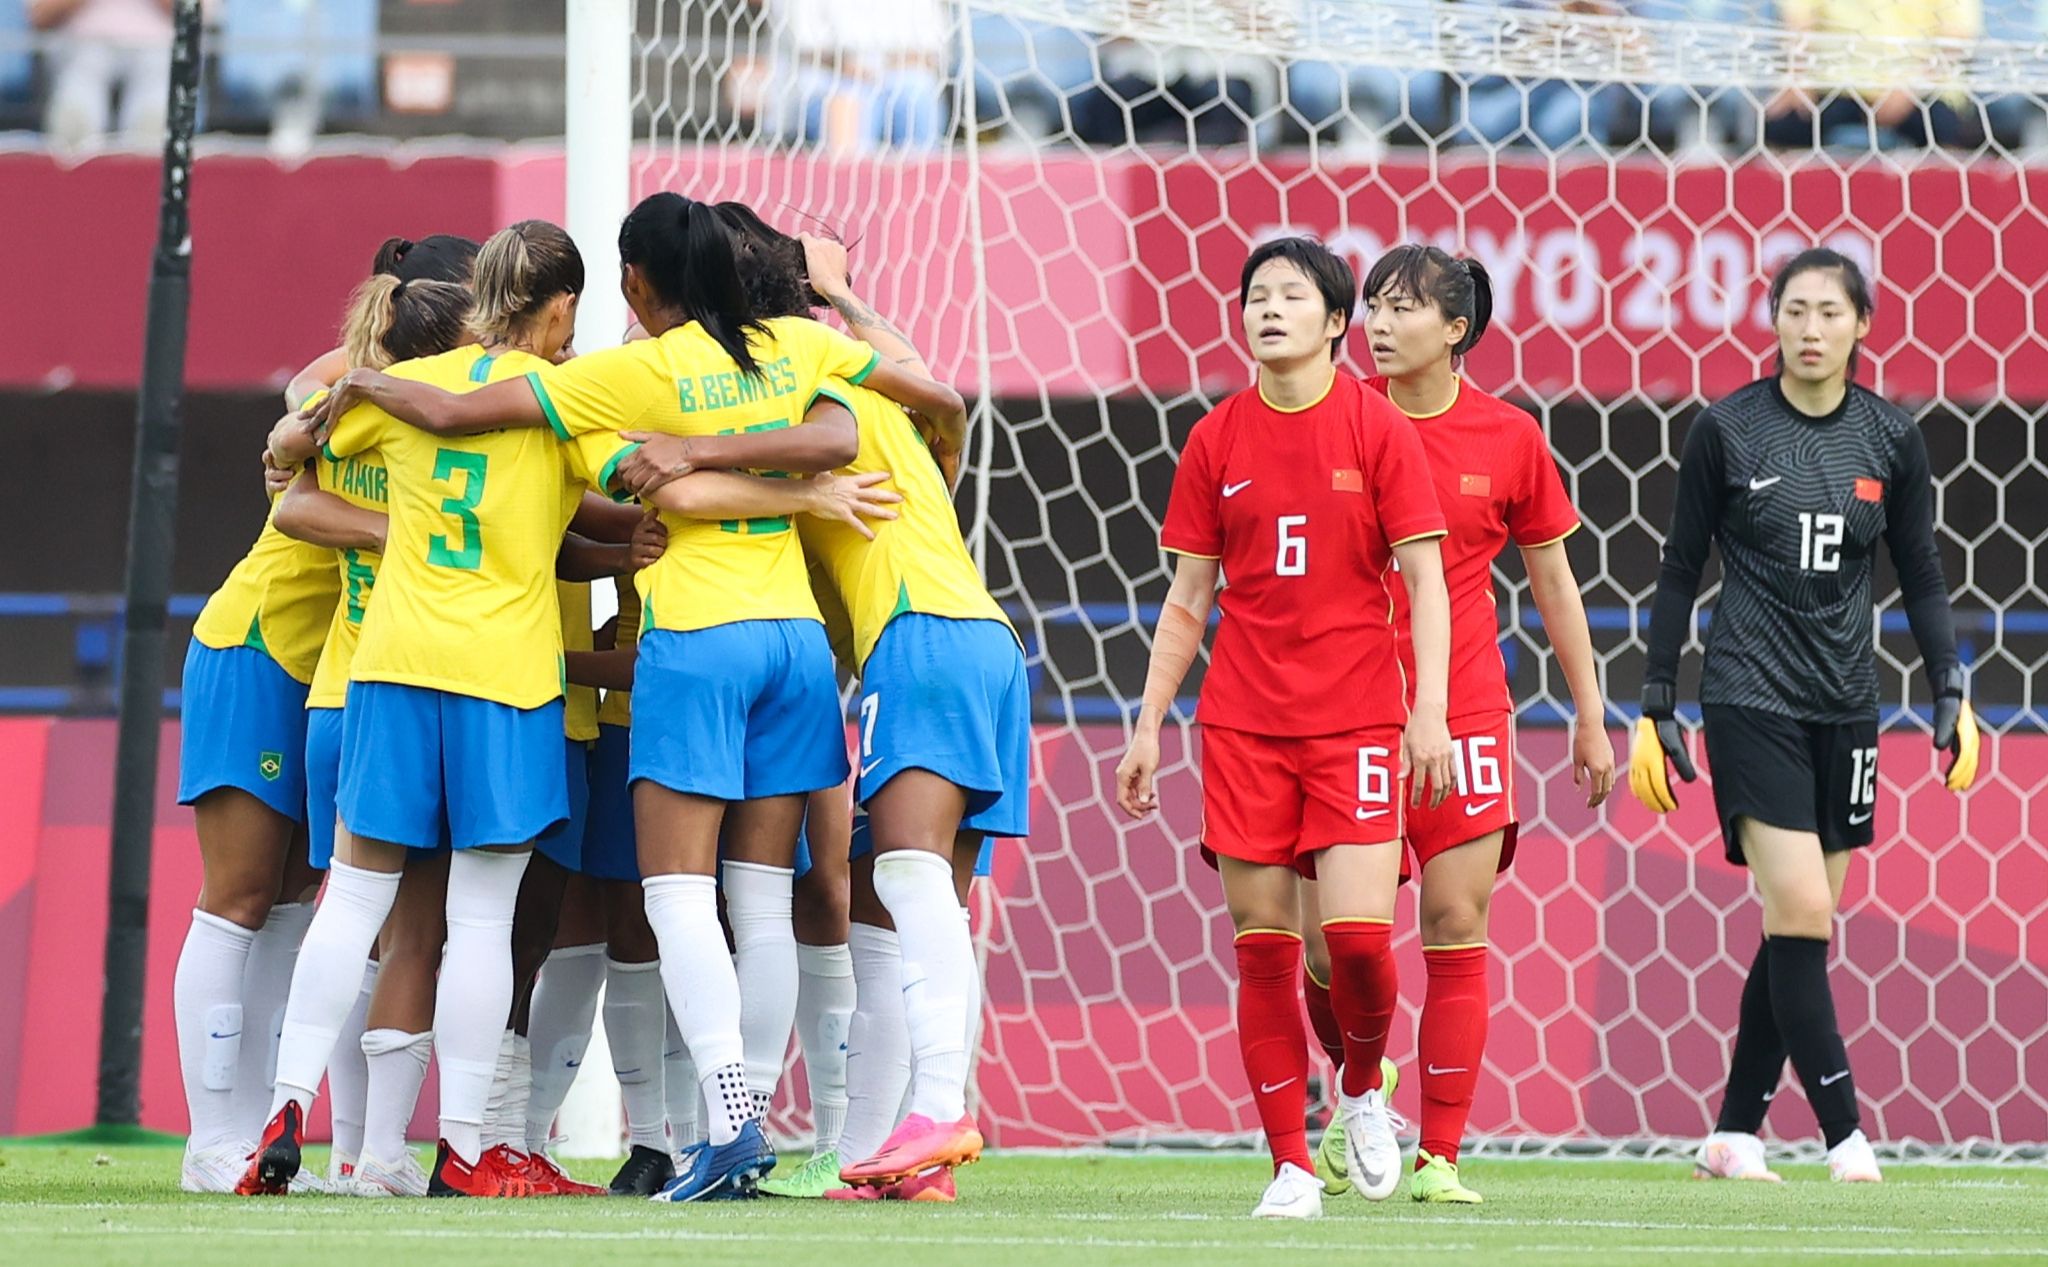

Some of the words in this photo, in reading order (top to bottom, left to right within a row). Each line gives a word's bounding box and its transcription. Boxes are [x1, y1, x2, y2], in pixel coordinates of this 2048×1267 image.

[1254, 224, 1600, 328] OYO
[427, 447, 489, 570] 3
[1275, 514, 1307, 576] 6
[1799, 512, 1845, 572] 12
[1356, 745, 1390, 803] 6
[1451, 736, 1503, 797] 16
[1849, 747, 1879, 805] 12
